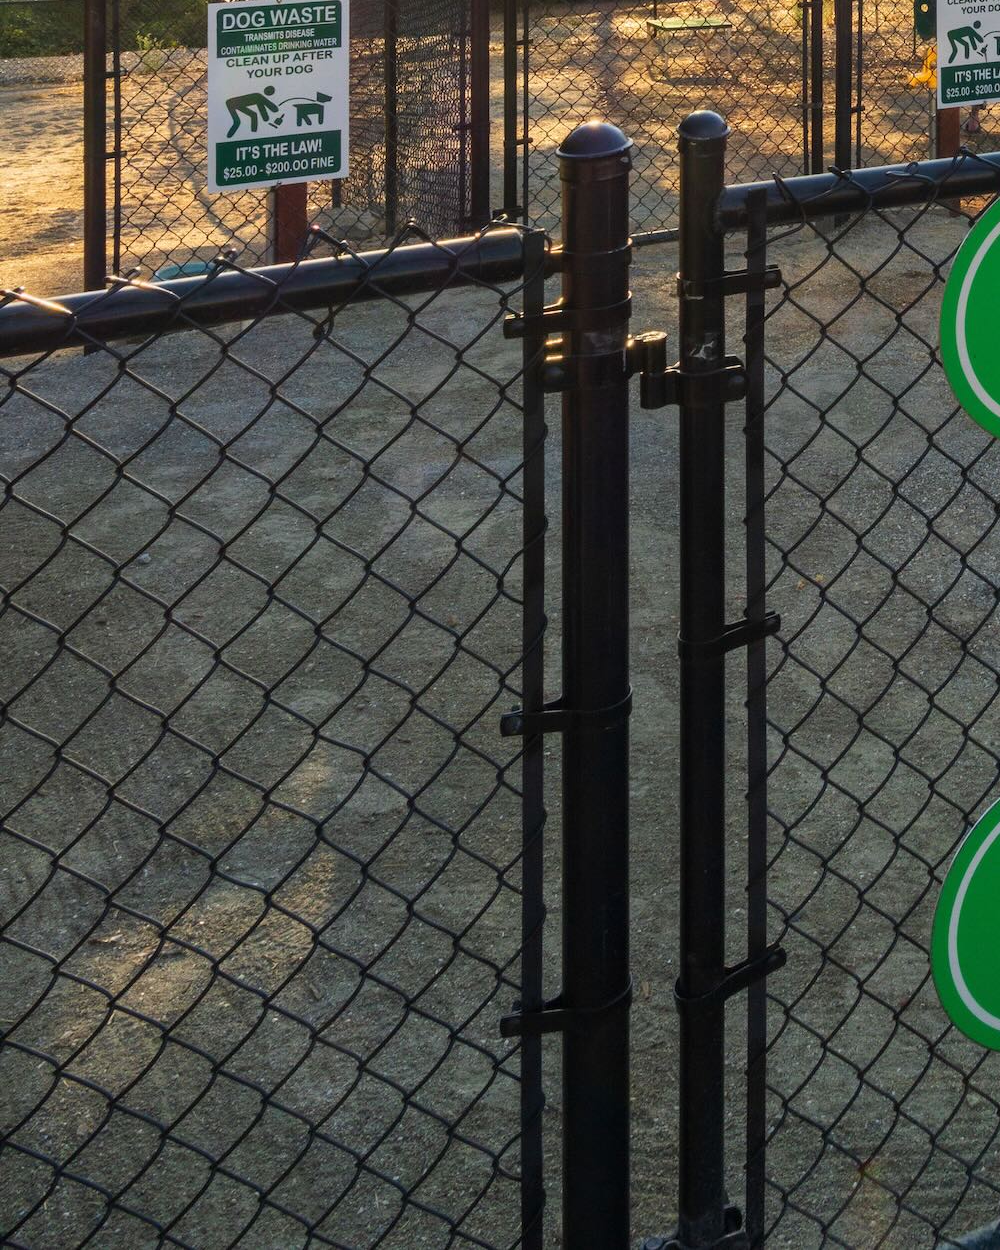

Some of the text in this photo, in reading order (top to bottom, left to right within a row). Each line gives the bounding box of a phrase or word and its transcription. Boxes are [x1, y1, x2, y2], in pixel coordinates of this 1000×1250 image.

[961, 5, 986, 14] YOUR
[223, 6, 336, 29] DOG WASTE
[245, 28, 314, 42] TRANSMITS DISEASE
[278, 40, 312, 50] DRINKING
[313, 38, 337, 47] WATER
[226, 50, 333, 68] CLEAN UP AFTER
[247, 65, 313, 78] YOUR DOG
[955, 70, 971, 83] IT'S
[973, 68, 991, 80] THE
[946, 87, 970, 99] $25.00
[237, 139, 322, 161] IT'S THE LAW!
[224, 165, 257, 181] $25.00
[311, 156, 334, 169] FINE
